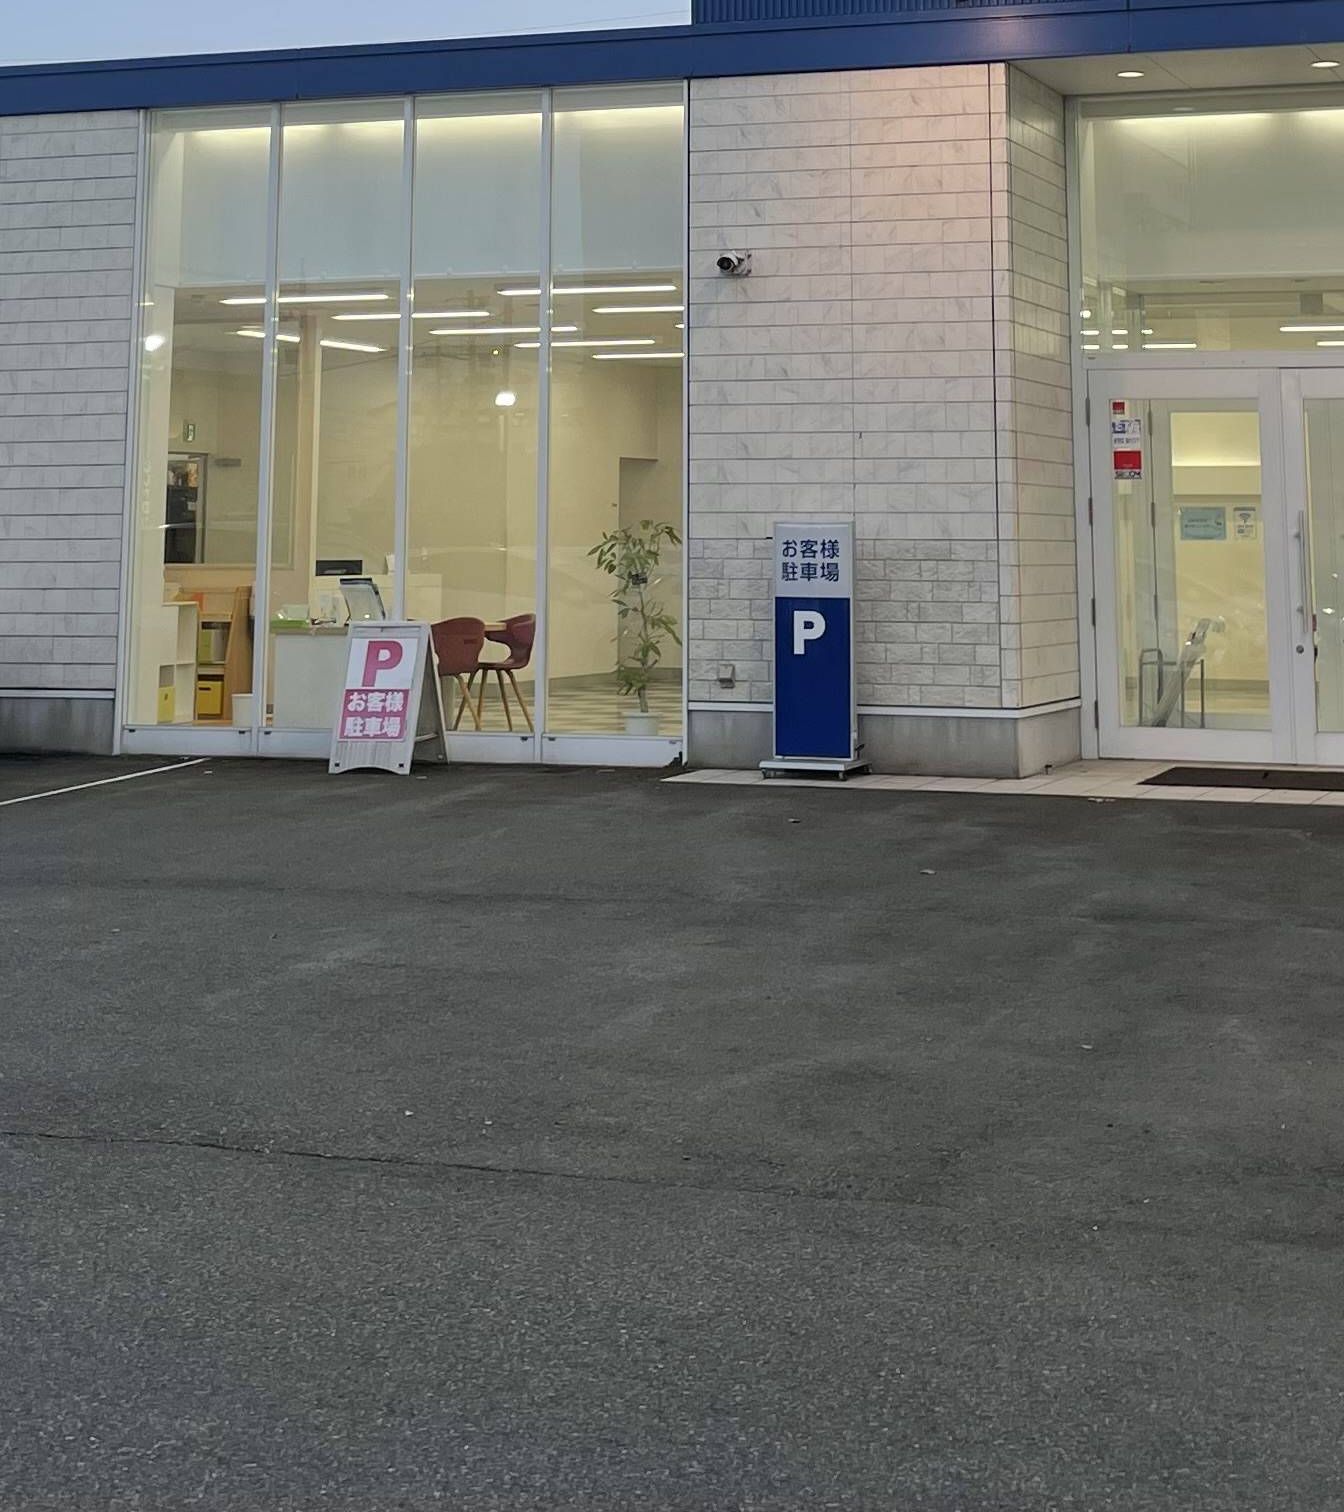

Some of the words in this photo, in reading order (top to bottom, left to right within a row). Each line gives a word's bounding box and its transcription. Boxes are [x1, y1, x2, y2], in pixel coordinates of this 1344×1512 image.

[782, 539, 840, 559] お客様
[782, 562, 840, 582] 駐車場
[794, 610, 826, 655] P
[362, 640, 403, 687] P
[347, 691, 405, 713] お客様
[344, 716, 402, 738] 駐車場
